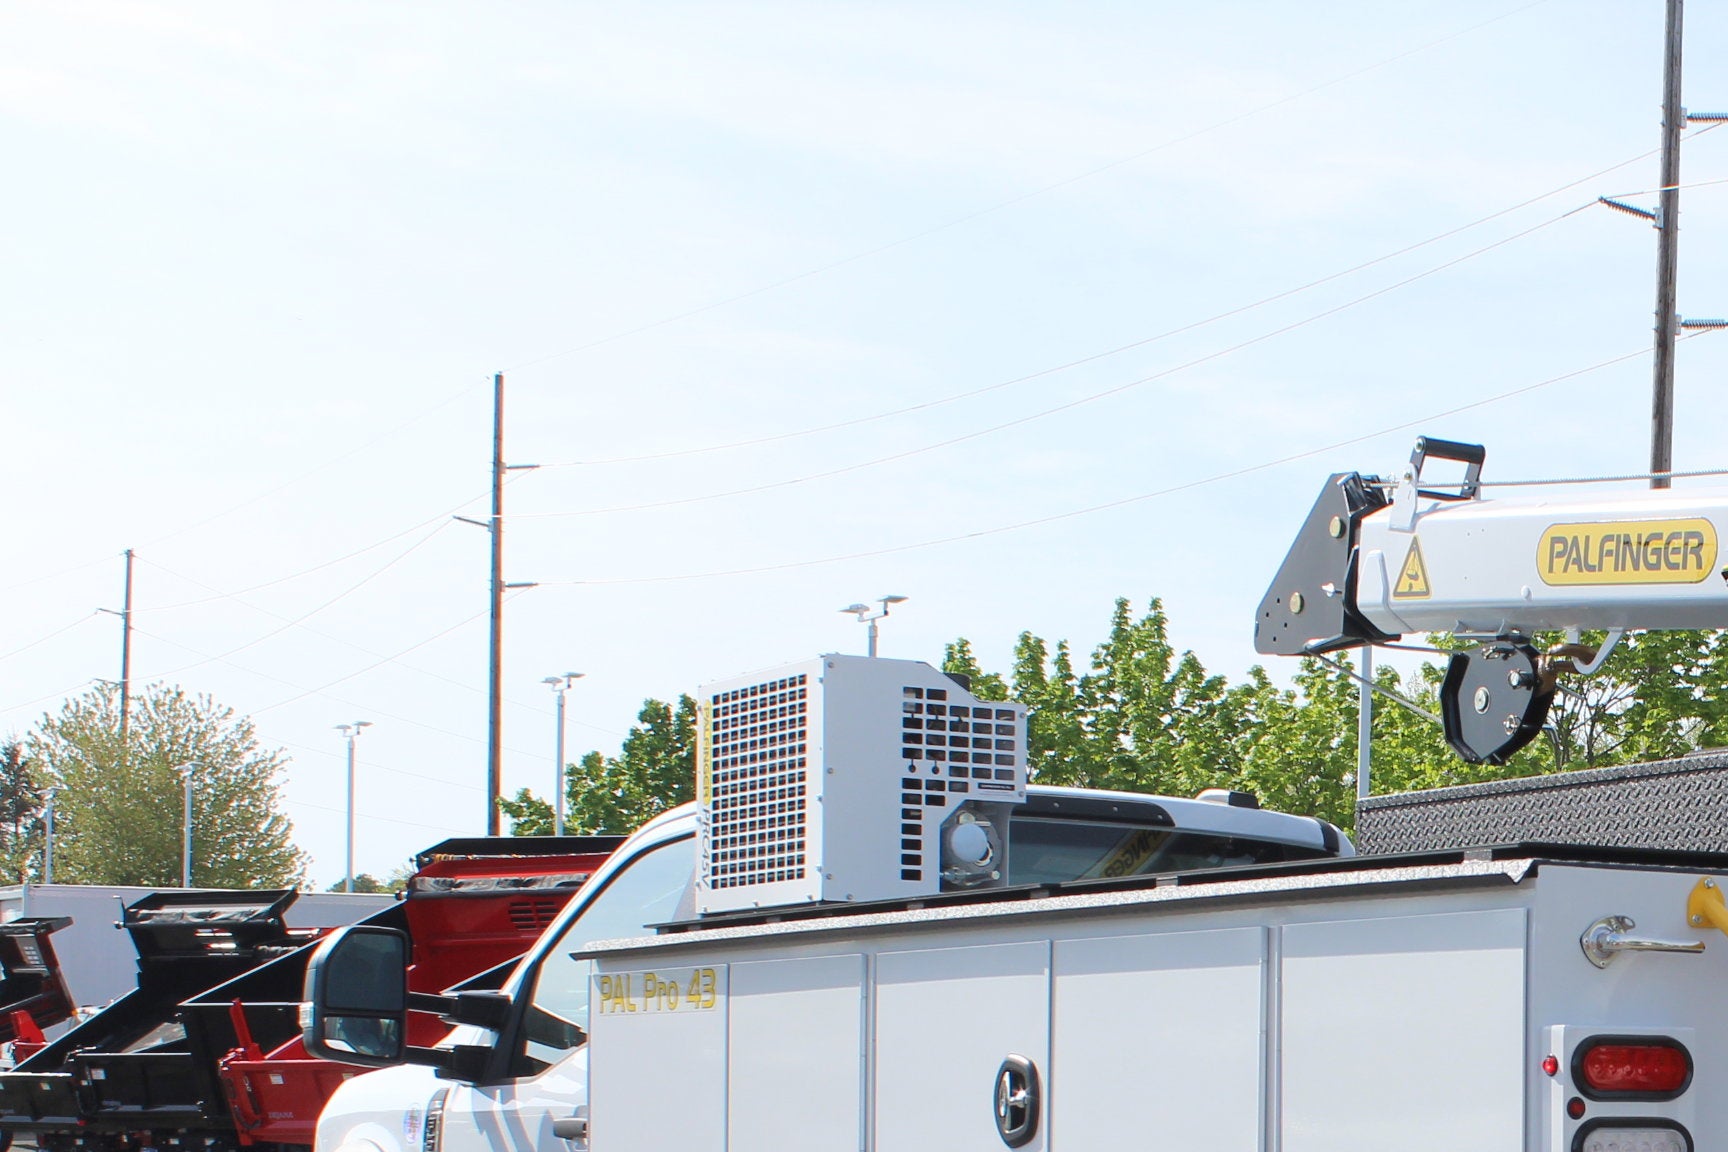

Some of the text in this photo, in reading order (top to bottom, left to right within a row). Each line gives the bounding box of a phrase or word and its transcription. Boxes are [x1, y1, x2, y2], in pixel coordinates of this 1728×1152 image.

[1547, 530, 1704, 574] PALFINGER
[701, 808, 711, 889] PRC45V
[599, 968, 716, 1014] PAL Pro 43
